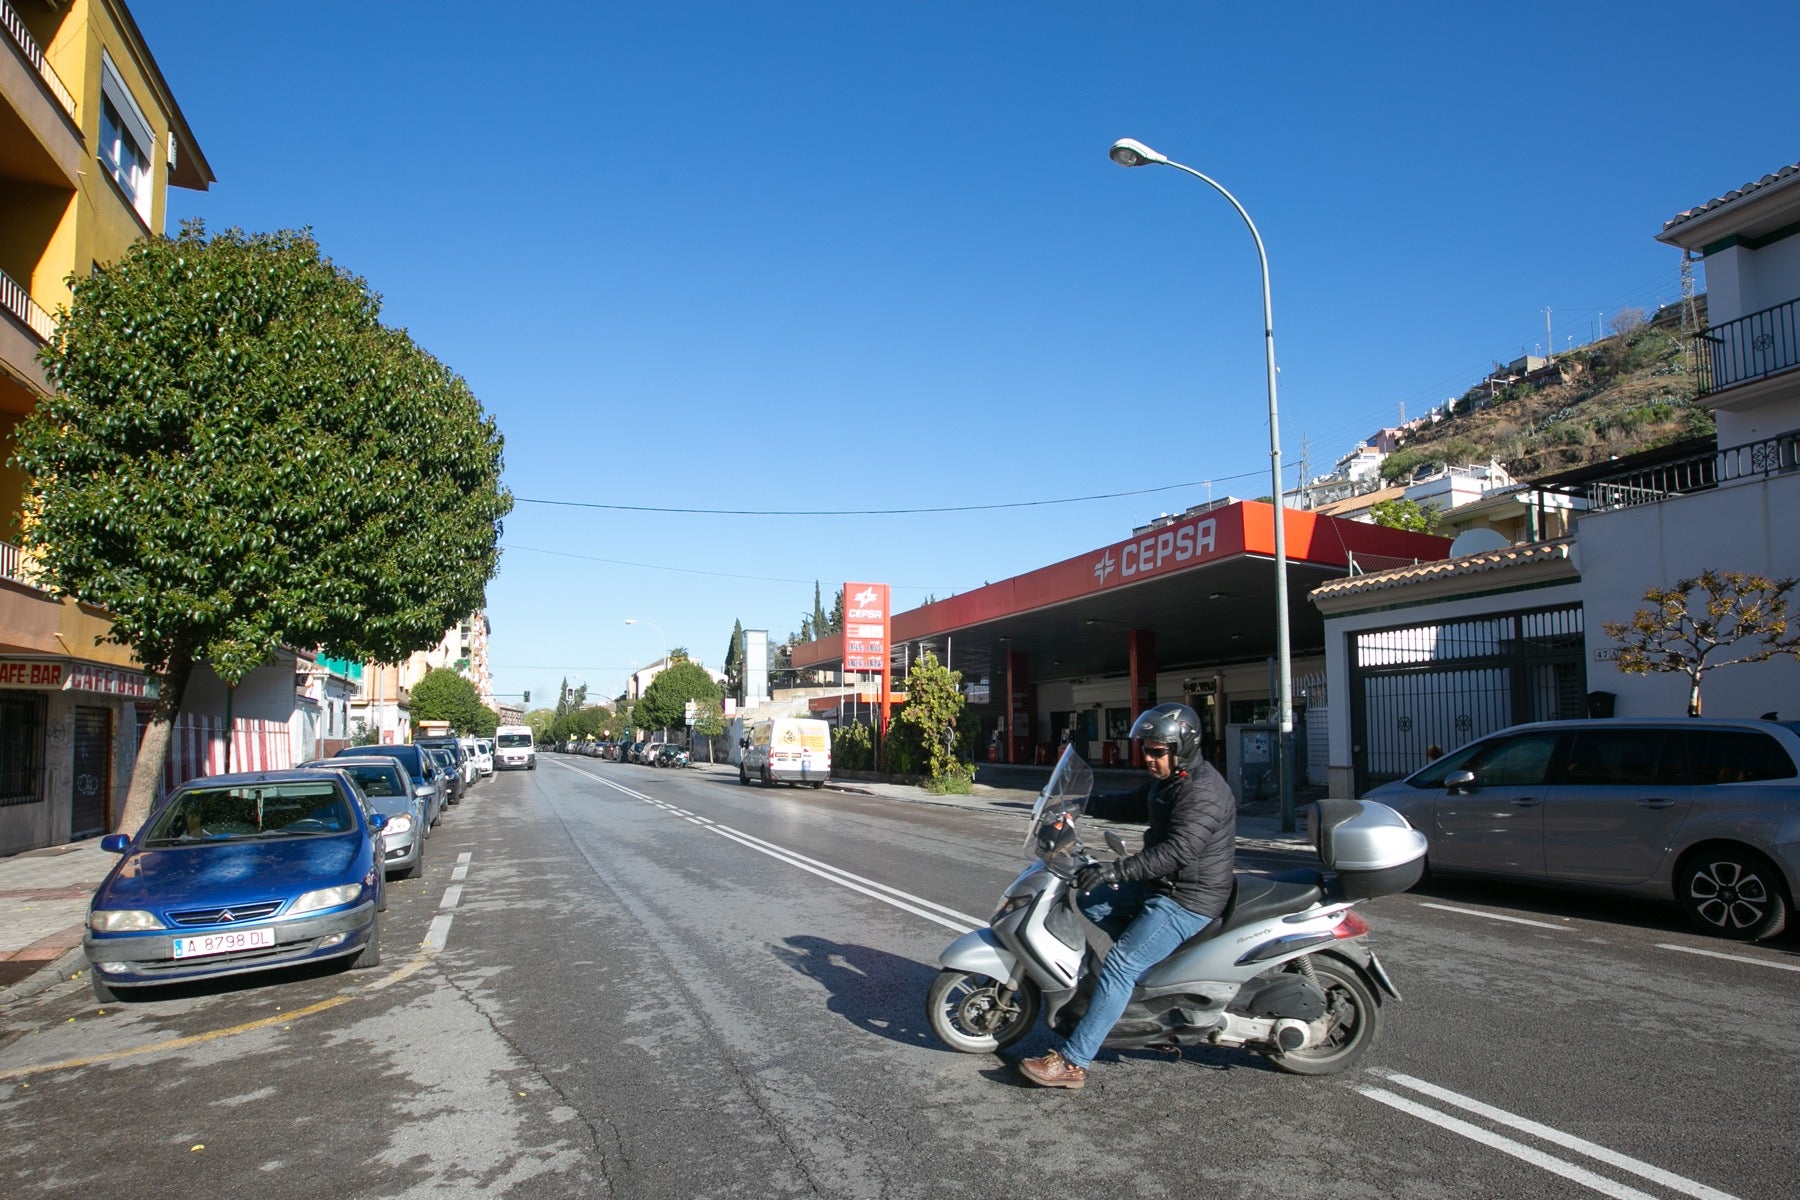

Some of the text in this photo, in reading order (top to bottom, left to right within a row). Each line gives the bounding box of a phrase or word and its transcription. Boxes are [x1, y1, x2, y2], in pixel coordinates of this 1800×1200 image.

[1121, 517, 1217, 577] CEPSA
[848, 608, 883, 619] CEPSA
[71, 664, 146, 698] CAFE BAR
[187, 931, 270, 953] A 8798 DL
